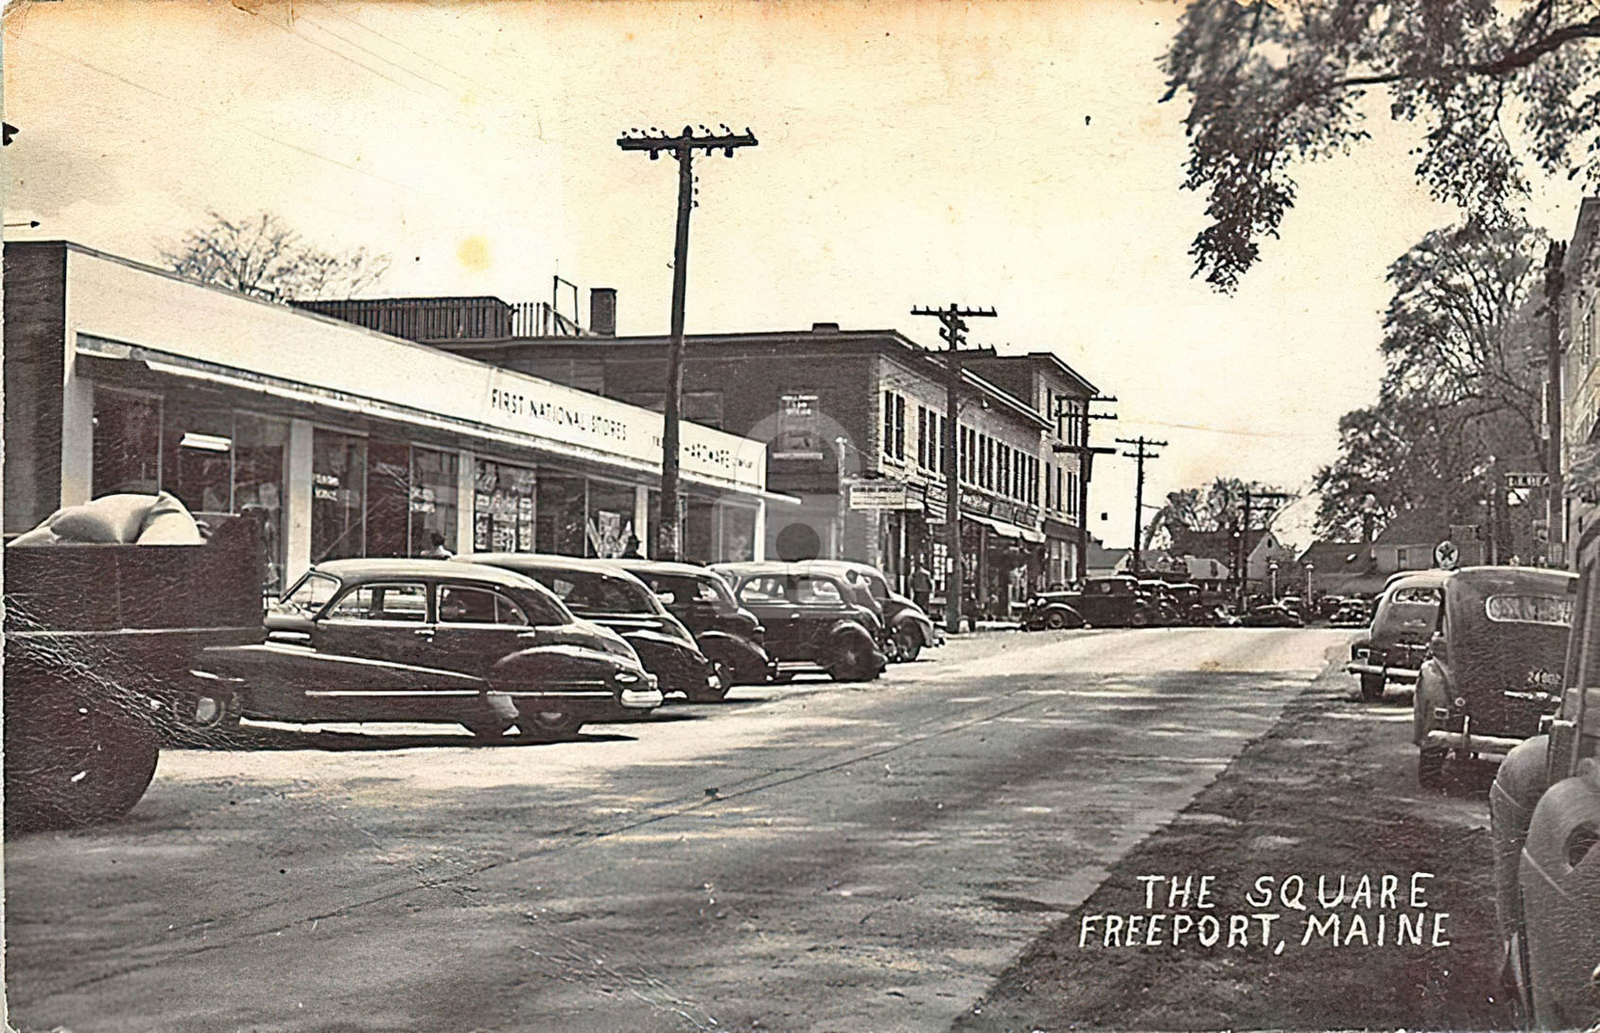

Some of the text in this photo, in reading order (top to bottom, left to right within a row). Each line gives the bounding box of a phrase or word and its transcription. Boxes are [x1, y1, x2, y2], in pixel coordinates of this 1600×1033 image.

[492, 388, 524, 415] FIRST
[530, 400, 586, 431] NATIONAL
[592, 415, 627, 441] STORES
